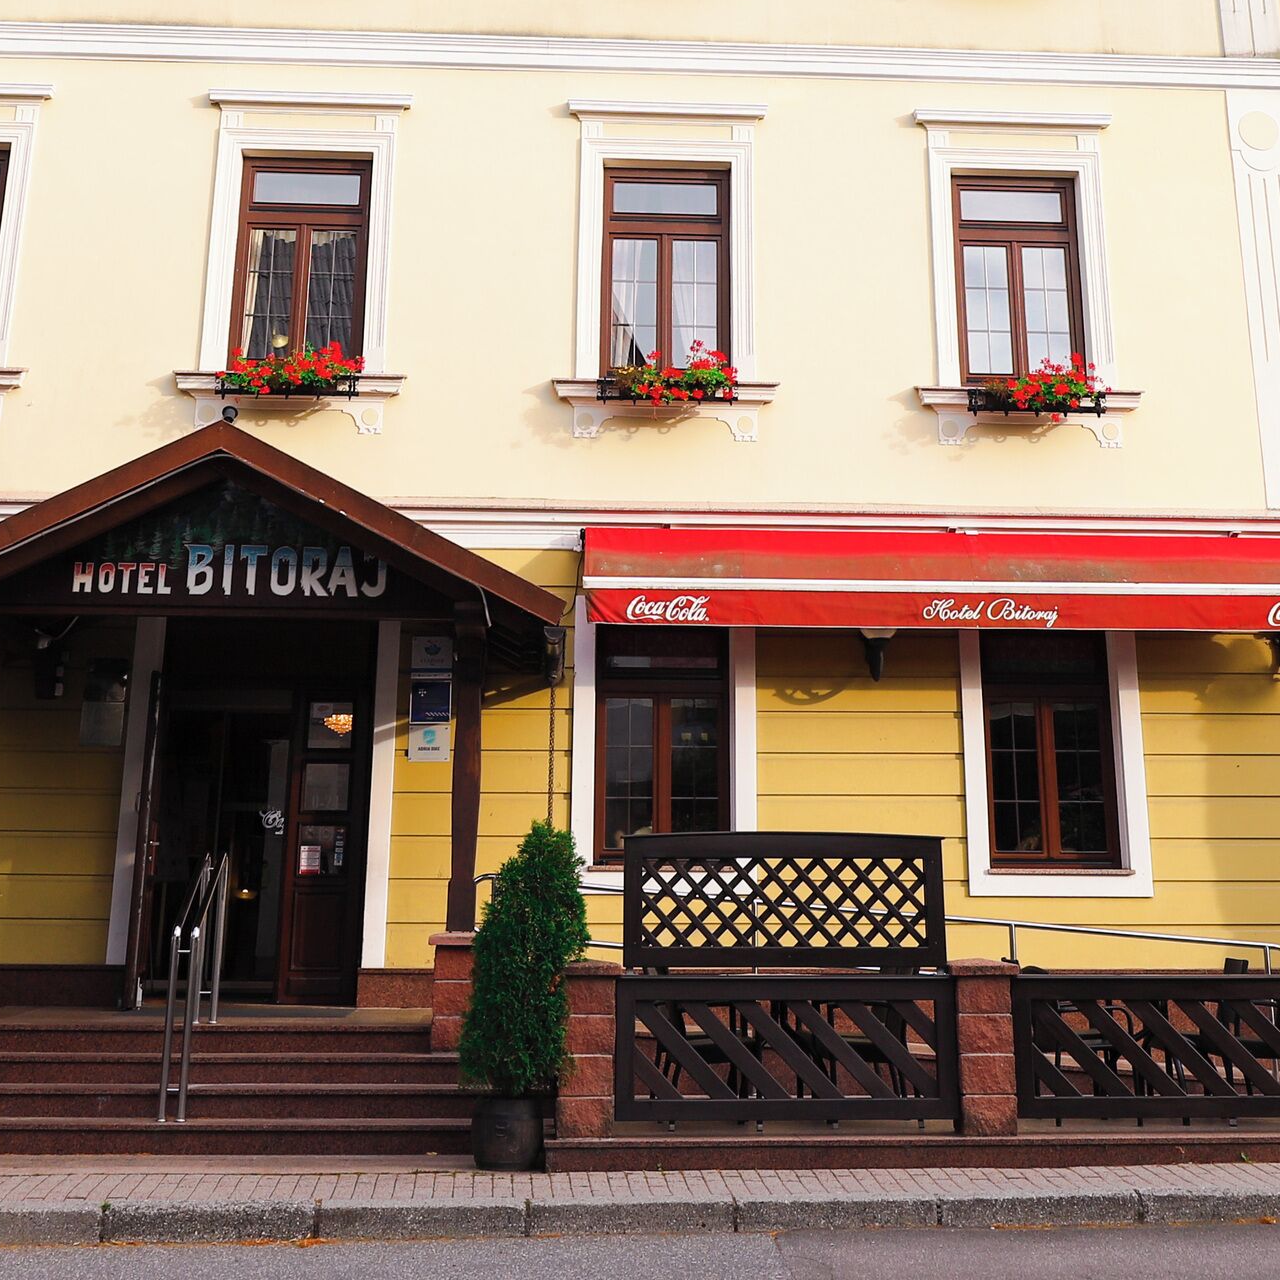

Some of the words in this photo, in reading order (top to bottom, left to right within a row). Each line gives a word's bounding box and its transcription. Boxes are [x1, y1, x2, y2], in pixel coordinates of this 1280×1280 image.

[72, 562, 171, 595] HOTEL
[184, 544, 388, 598] BITORAJ
[626, 595, 711, 622] Coca-Cola
[923, 599, 985, 621] Hotel
[986, 598, 1059, 628] Bitoraj
